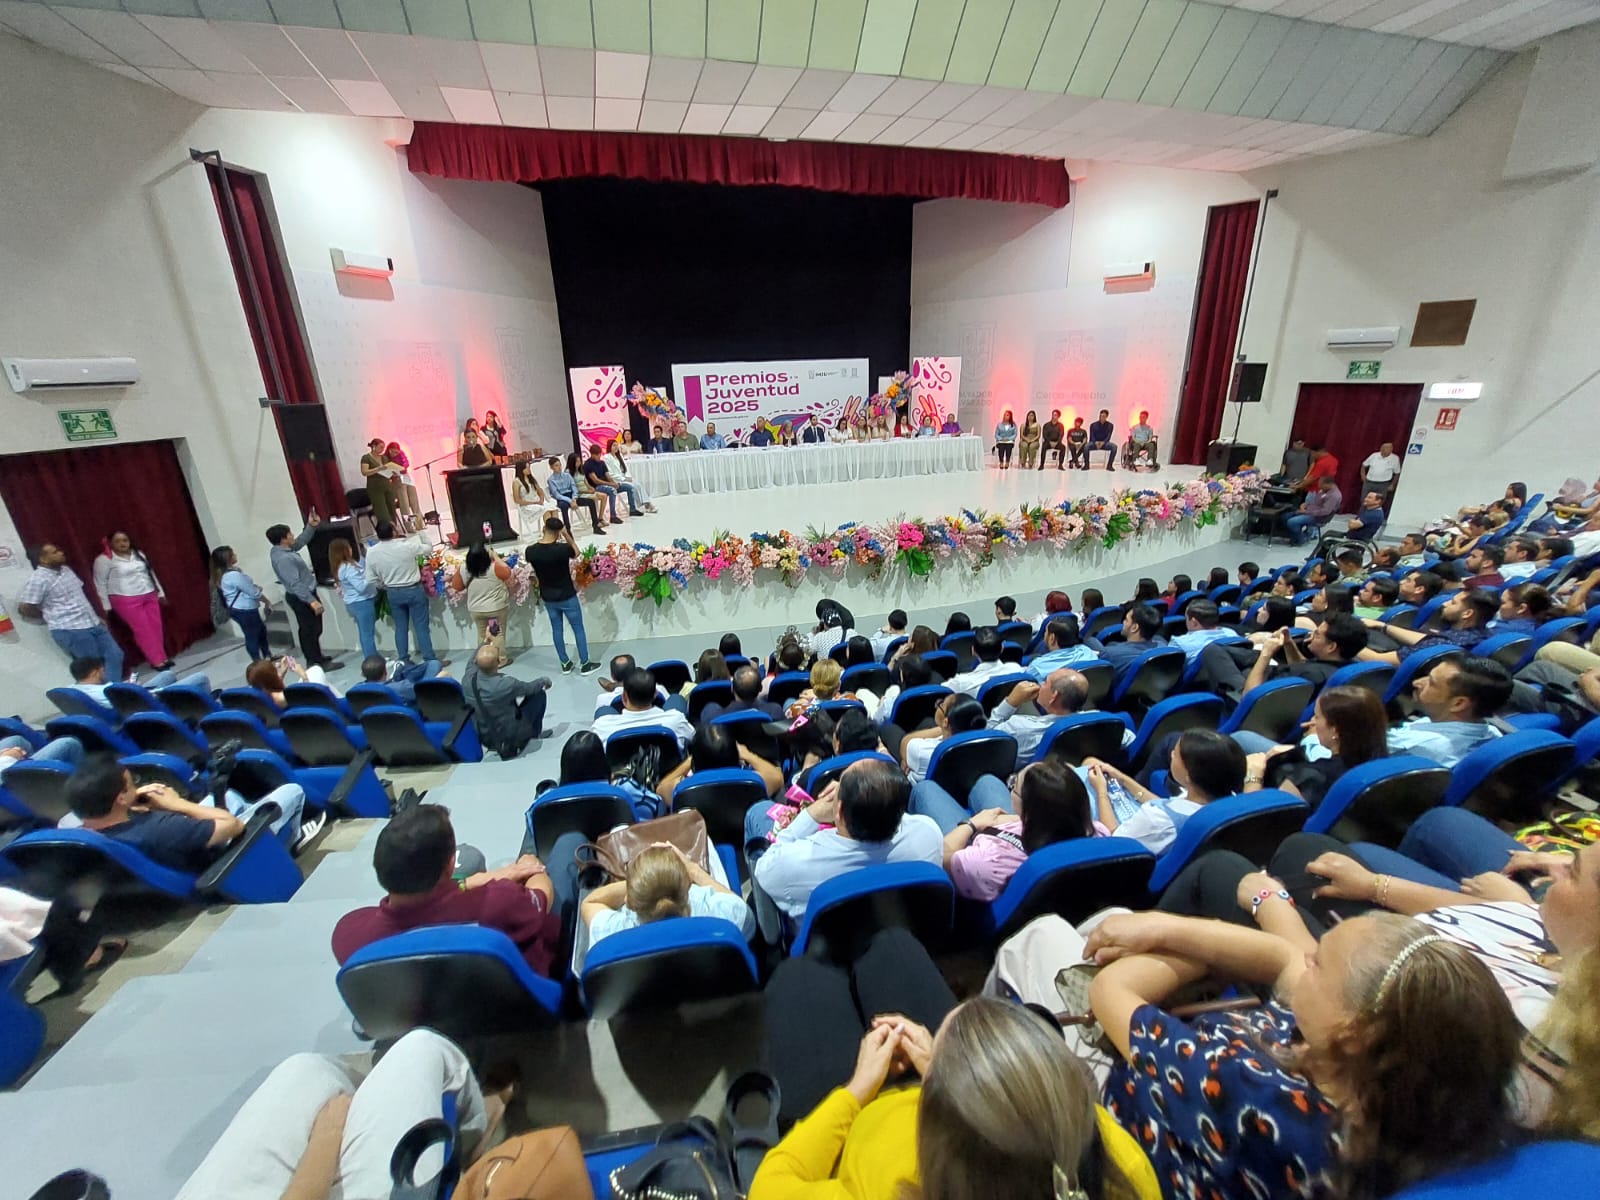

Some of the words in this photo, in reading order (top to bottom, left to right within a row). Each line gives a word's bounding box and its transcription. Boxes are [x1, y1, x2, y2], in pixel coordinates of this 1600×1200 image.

[705, 371, 788, 386] Premios
[705, 383, 800, 400] Juventud
[707, 400, 760, 414] 2025
